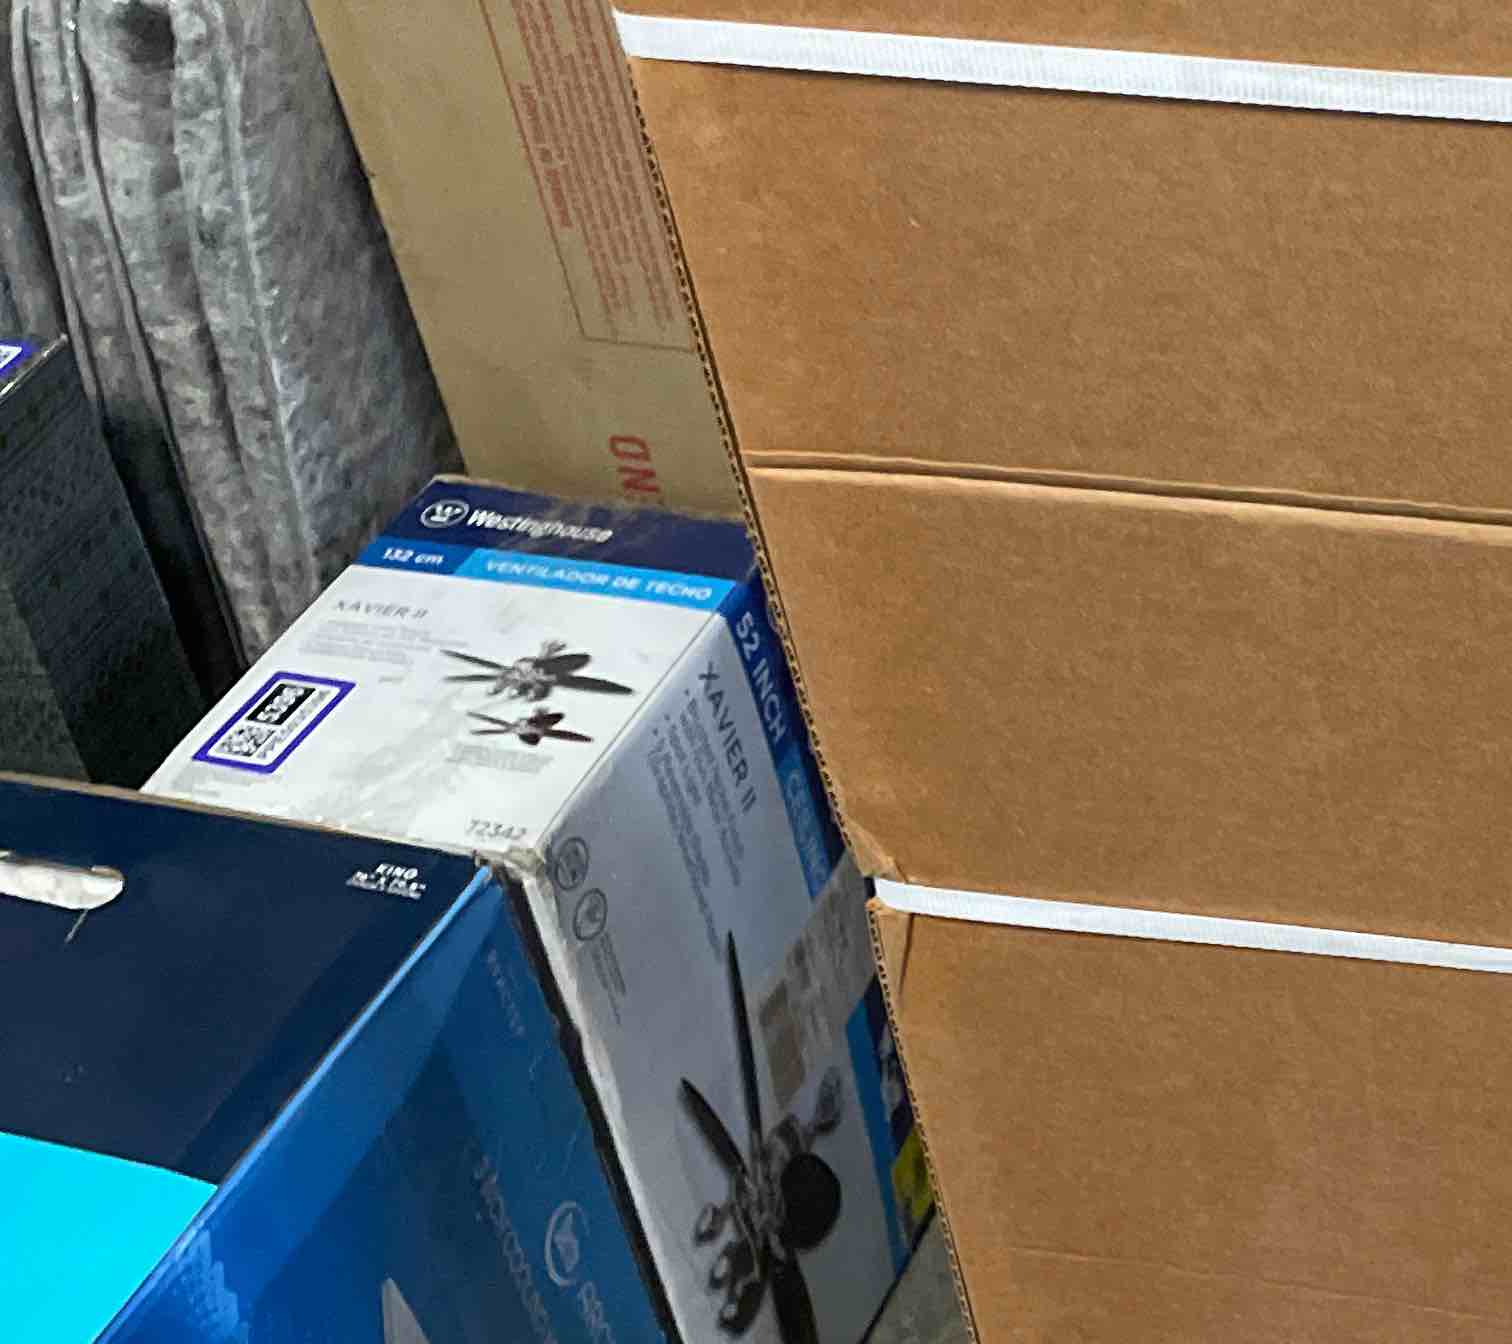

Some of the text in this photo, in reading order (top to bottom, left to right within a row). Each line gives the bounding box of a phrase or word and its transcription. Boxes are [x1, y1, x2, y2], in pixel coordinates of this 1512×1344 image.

[466, 508, 613, 544] Westinghouse
[486, 560, 609, 585] VENTILADOR
[612, 575, 641, 590] DE
[334, 599, 410, 620] XAVIER
[735, 610, 787, 744] 52 INCH
[698, 661, 748, 786] XAVIER
